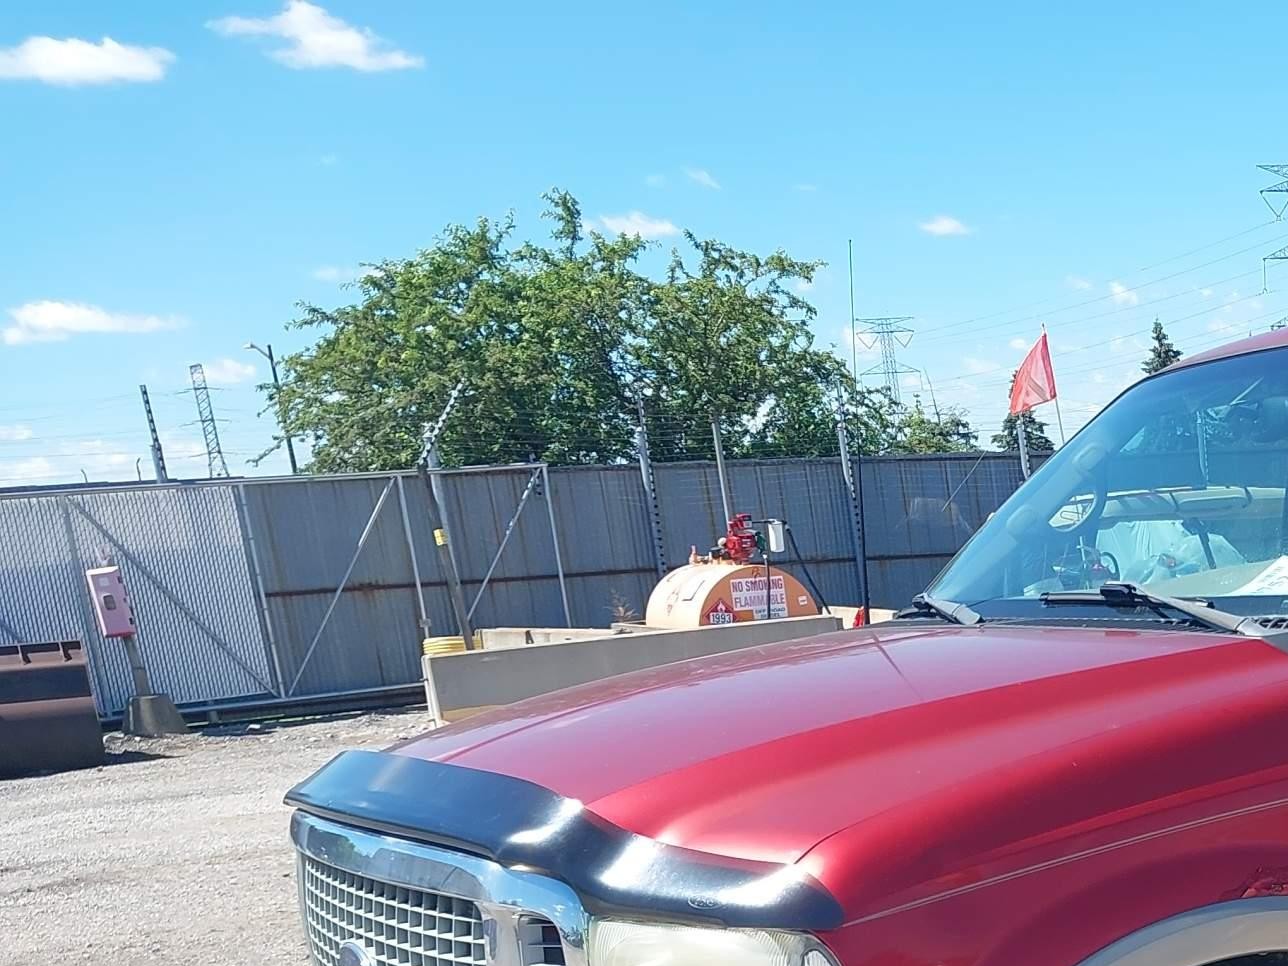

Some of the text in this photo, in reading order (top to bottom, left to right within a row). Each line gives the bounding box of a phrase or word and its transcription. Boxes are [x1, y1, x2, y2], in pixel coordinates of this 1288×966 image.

[732, 579, 782, 593] NO SMOKNG
[712, 613, 731, 623] 1993
